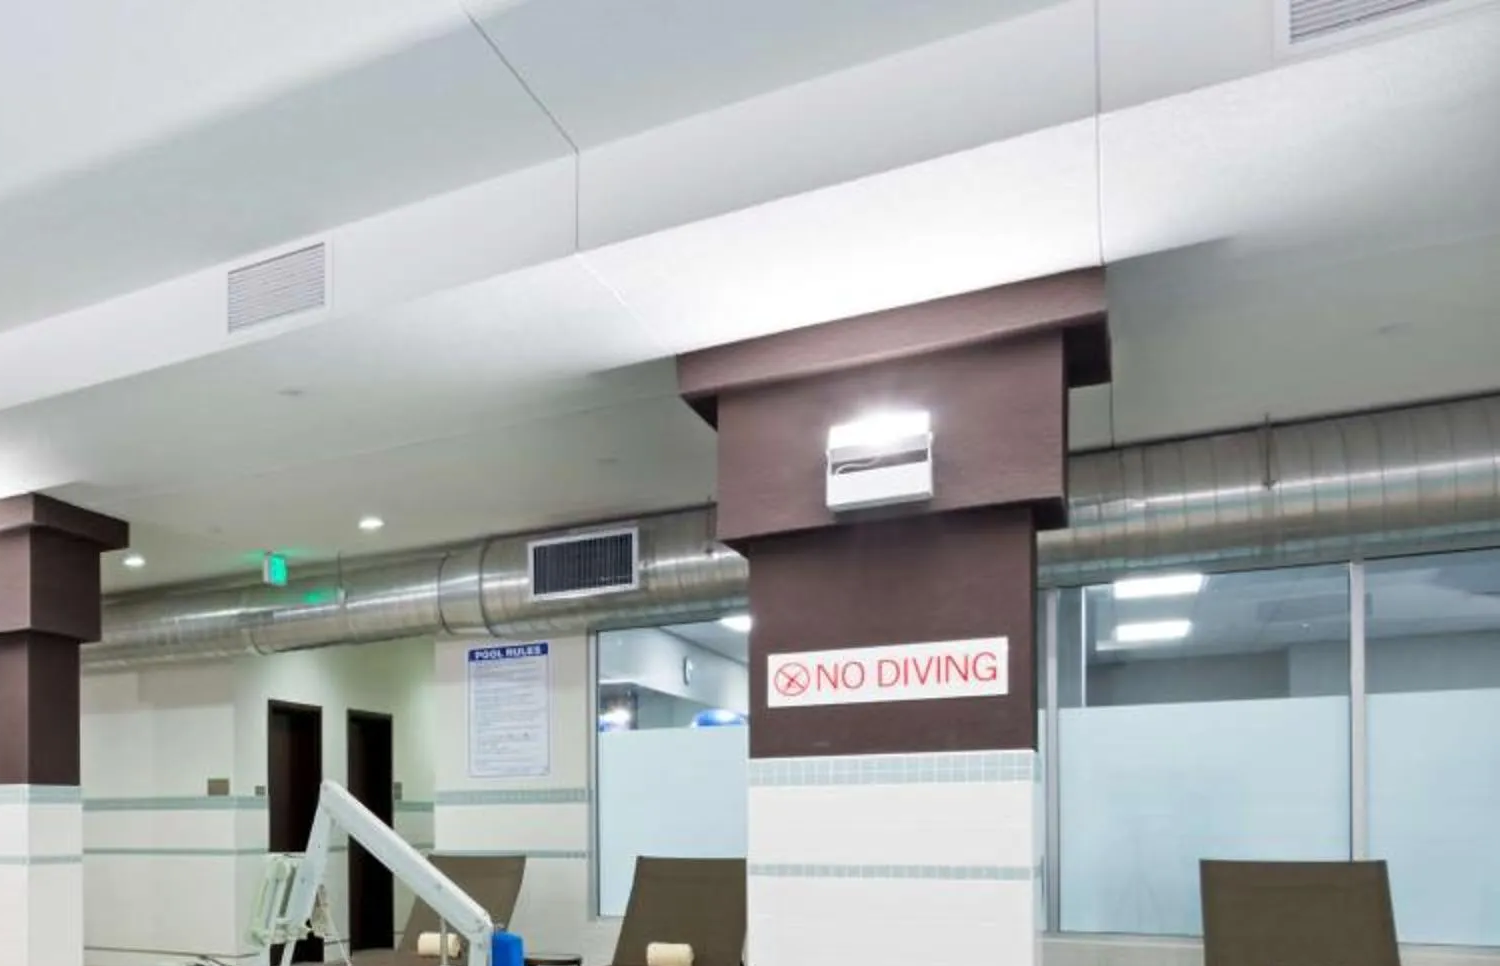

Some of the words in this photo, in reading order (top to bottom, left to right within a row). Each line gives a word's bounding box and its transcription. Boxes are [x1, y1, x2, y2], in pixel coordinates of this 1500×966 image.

[474, 648, 504, 660] POOL
[505, 645, 541, 657] RULES
[816, 661, 866, 691] NO
[877, 651, 997, 687] DIVING
